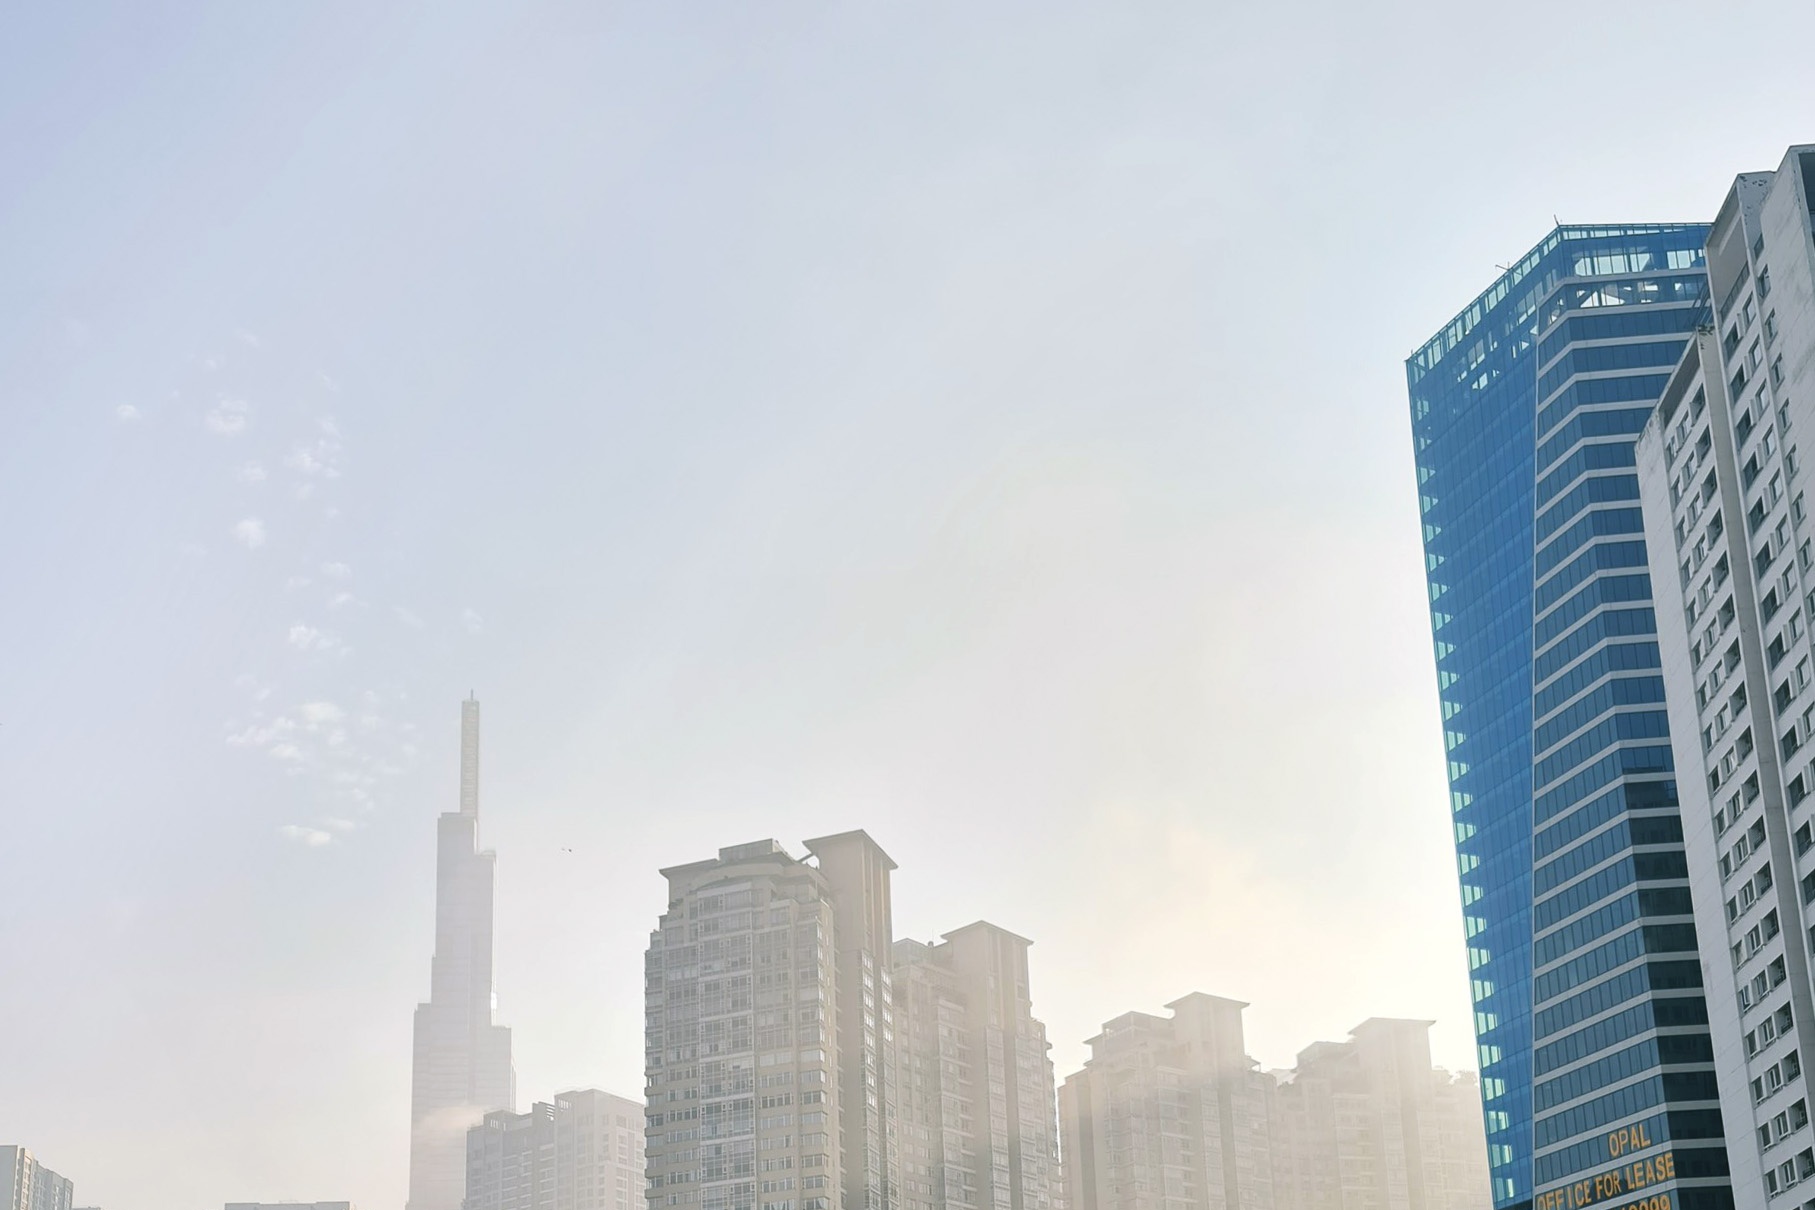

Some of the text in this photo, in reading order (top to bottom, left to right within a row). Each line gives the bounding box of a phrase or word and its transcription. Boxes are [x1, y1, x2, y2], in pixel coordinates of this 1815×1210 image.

[1609, 1124, 1651, 1157] OPAL
[1595, 1170, 1621, 1200] FOR
[1625, 1152, 1676, 1190] LEASE
